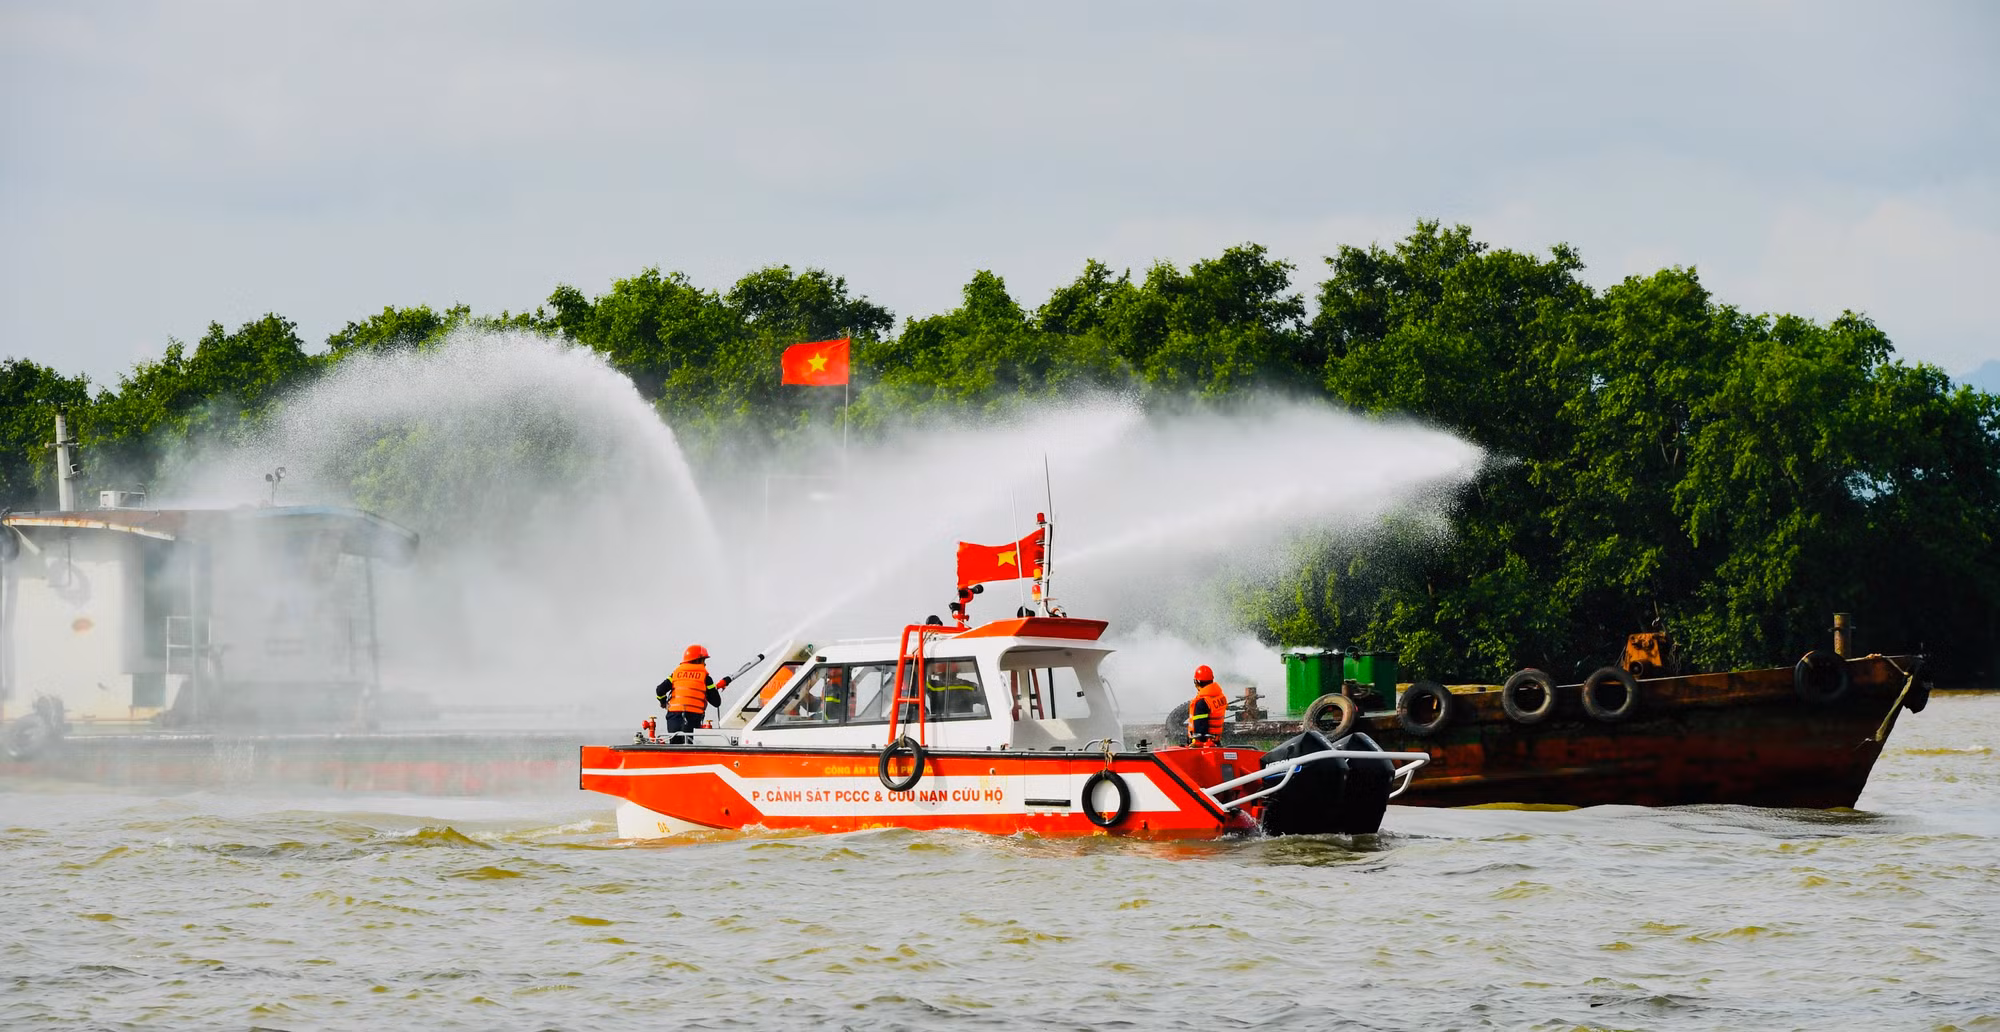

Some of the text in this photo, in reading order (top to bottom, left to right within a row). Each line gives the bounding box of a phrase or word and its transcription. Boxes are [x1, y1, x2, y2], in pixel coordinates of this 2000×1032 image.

[677, 671, 702, 680] CAND
[806, 788, 831, 802] SÁT
[835, 790, 870, 802] PCCC
[874, 790, 883, 802] &
[920, 790, 948, 805] NẠN
[952, 786, 980, 802] CỨU
[984, 786, 1003, 805] HỘ
